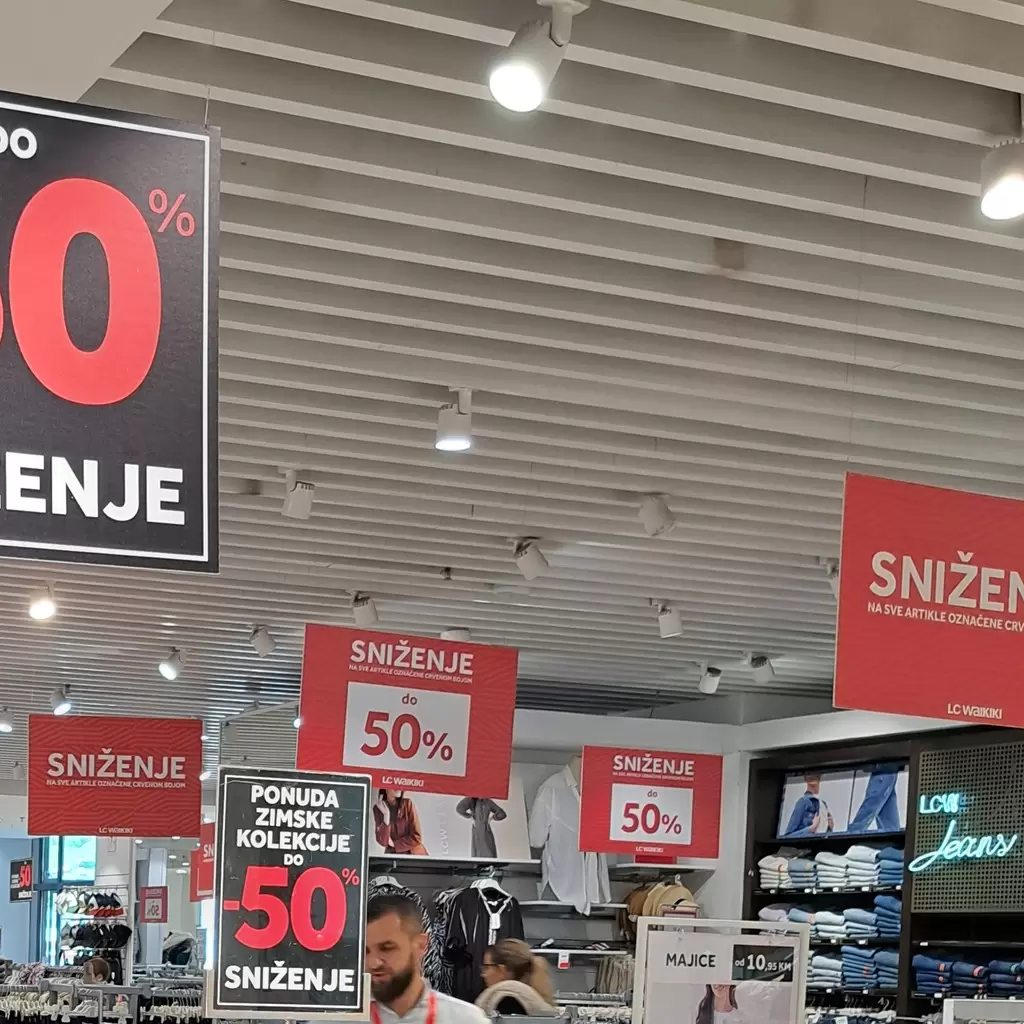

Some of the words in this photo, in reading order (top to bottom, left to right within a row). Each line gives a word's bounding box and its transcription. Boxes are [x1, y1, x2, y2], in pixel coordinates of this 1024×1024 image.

[868, 602, 882, 613] NA
[884, 606, 903, 616] SVE
[905, 607, 946, 622] ARTIKLE
[948, 613, 1003, 630] OZNAČENE
[350, 640, 473, 675] SNIŽENJE
[402, 693, 417, 705] do
[947, 703, 961, 714] LC
[361, 711, 453, 761] 50%
[47, 748, 186, 779] SNIŽENJE
[613, 753, 694, 775] SNIŽENJE
[382, 776, 392, 784] LC
[251, 785, 339, 808] PONUDA
[255, 808, 333, 830] ZIMSKE
[621, 803, 682, 834] 50%
[236, 829, 350, 853] KOLEKCIJE
[908, 820, 1017, 872] Jeans
[283, 853, 304, 866] DO
[666, 953, 716, 968] MAJICE
[735, 958, 745, 967] od
[747, 954, 777, 972] 10,95
[224, 960, 355, 992] SNIŽENJE
